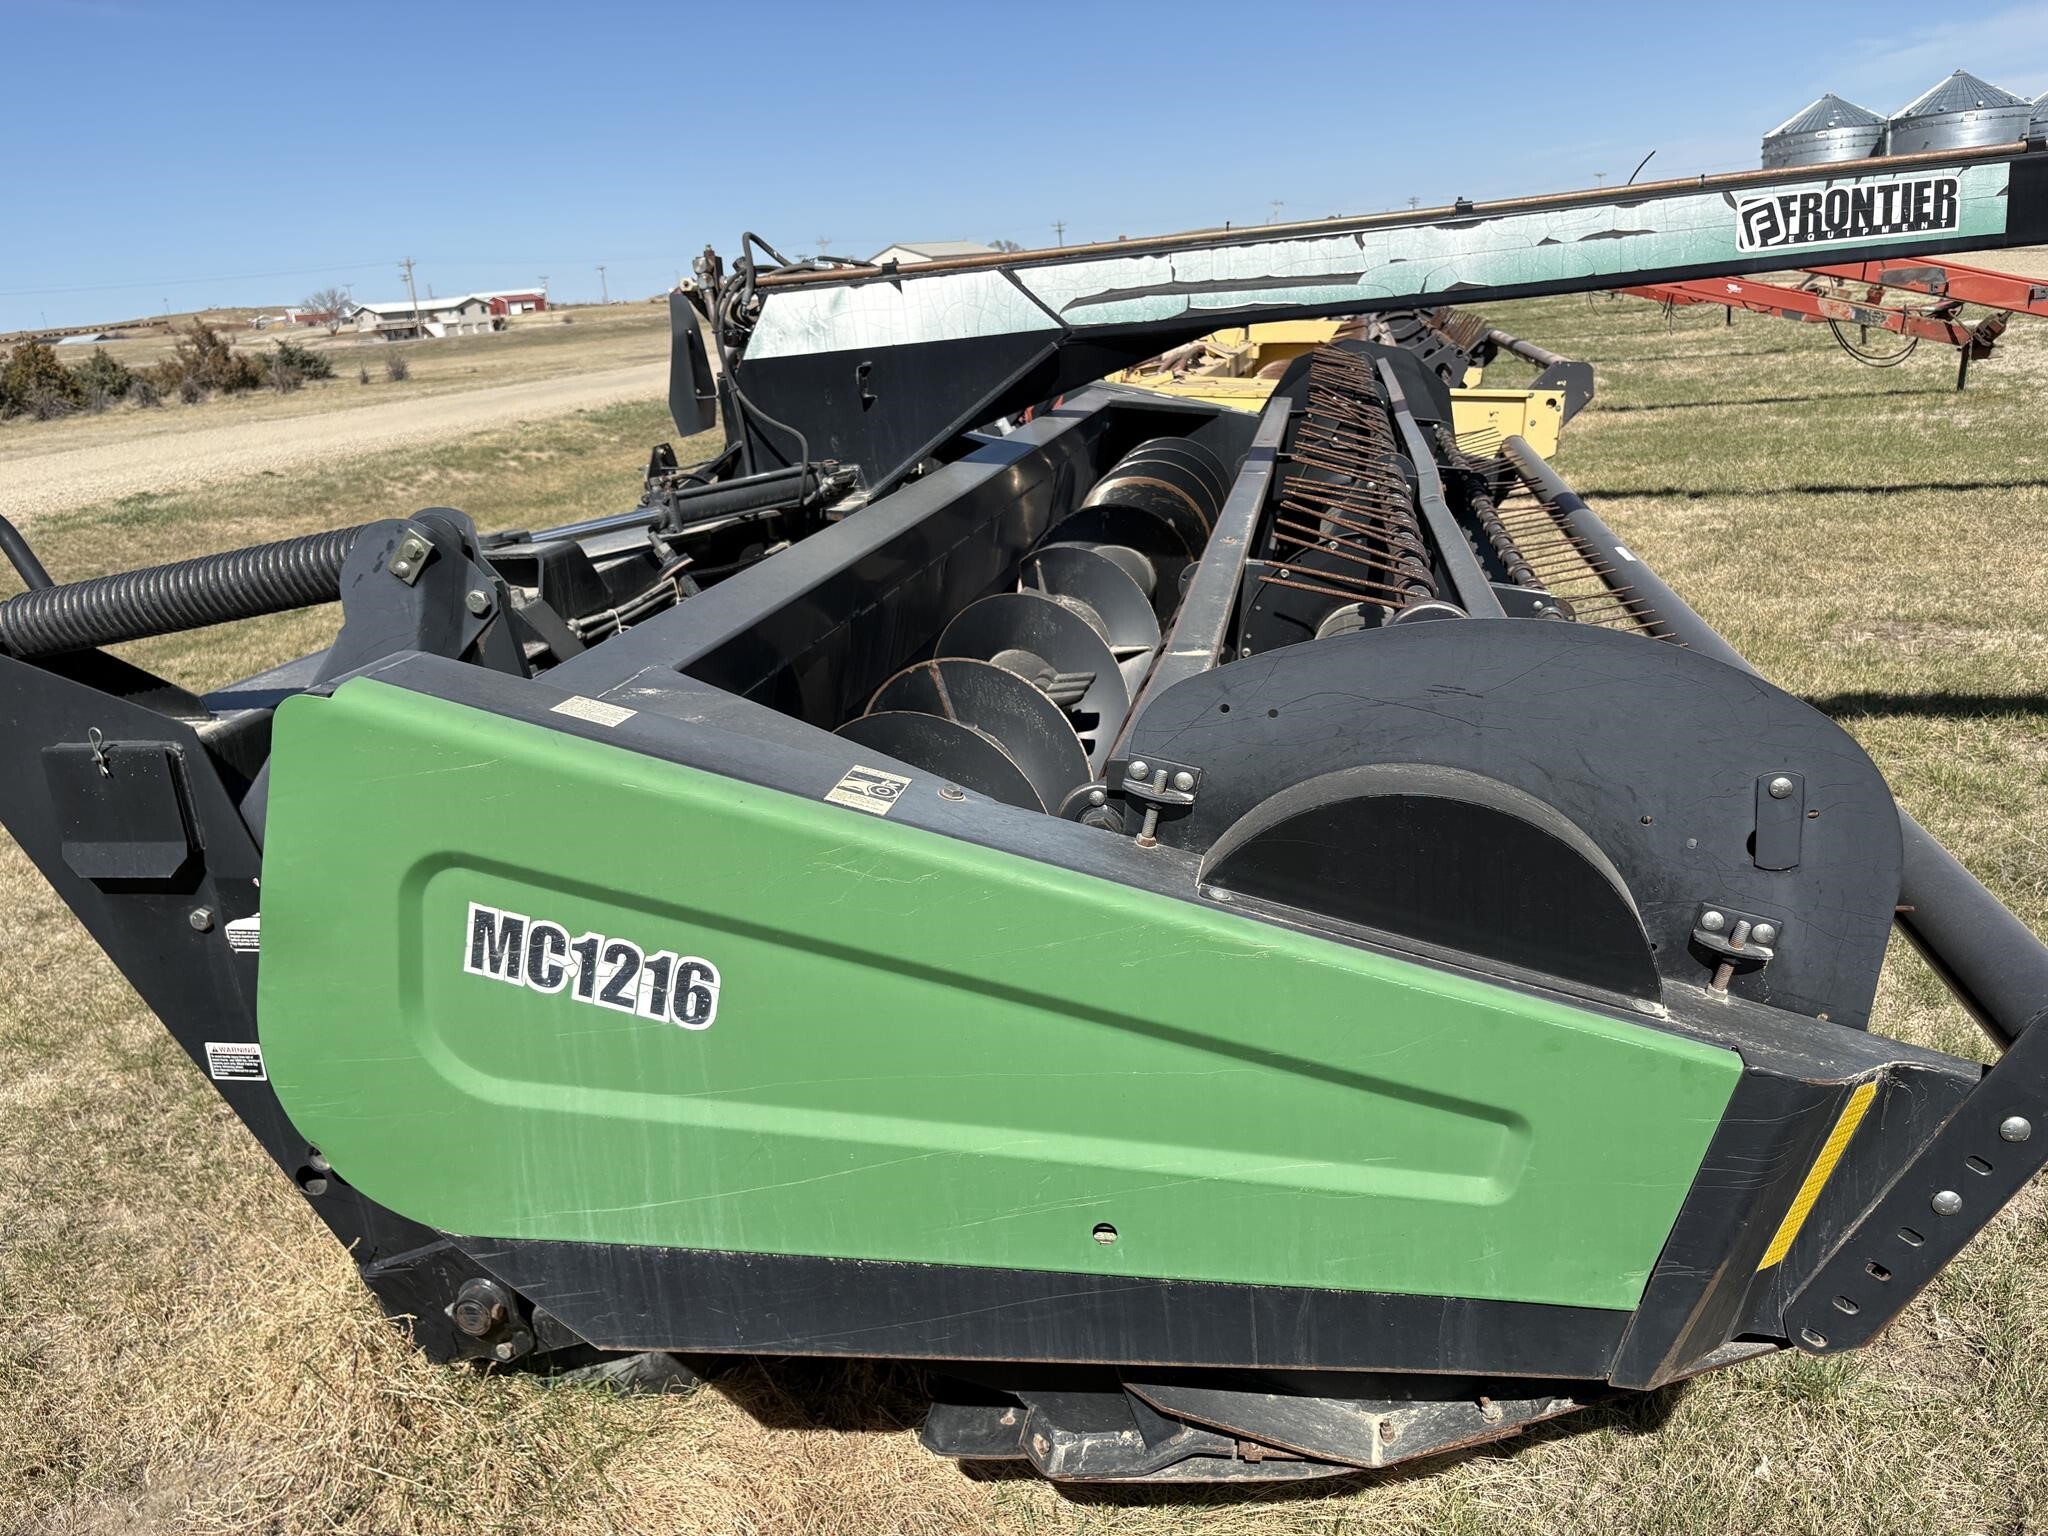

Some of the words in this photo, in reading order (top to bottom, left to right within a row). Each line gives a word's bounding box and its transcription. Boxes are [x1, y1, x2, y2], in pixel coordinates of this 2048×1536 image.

[1777, 178, 1958, 238] FRONTIER
[1788, 219, 1949, 245] EQUIPMENT
[468, 907, 717, 1026] MC1216
[219, 1046, 257, 1055] WARNING
